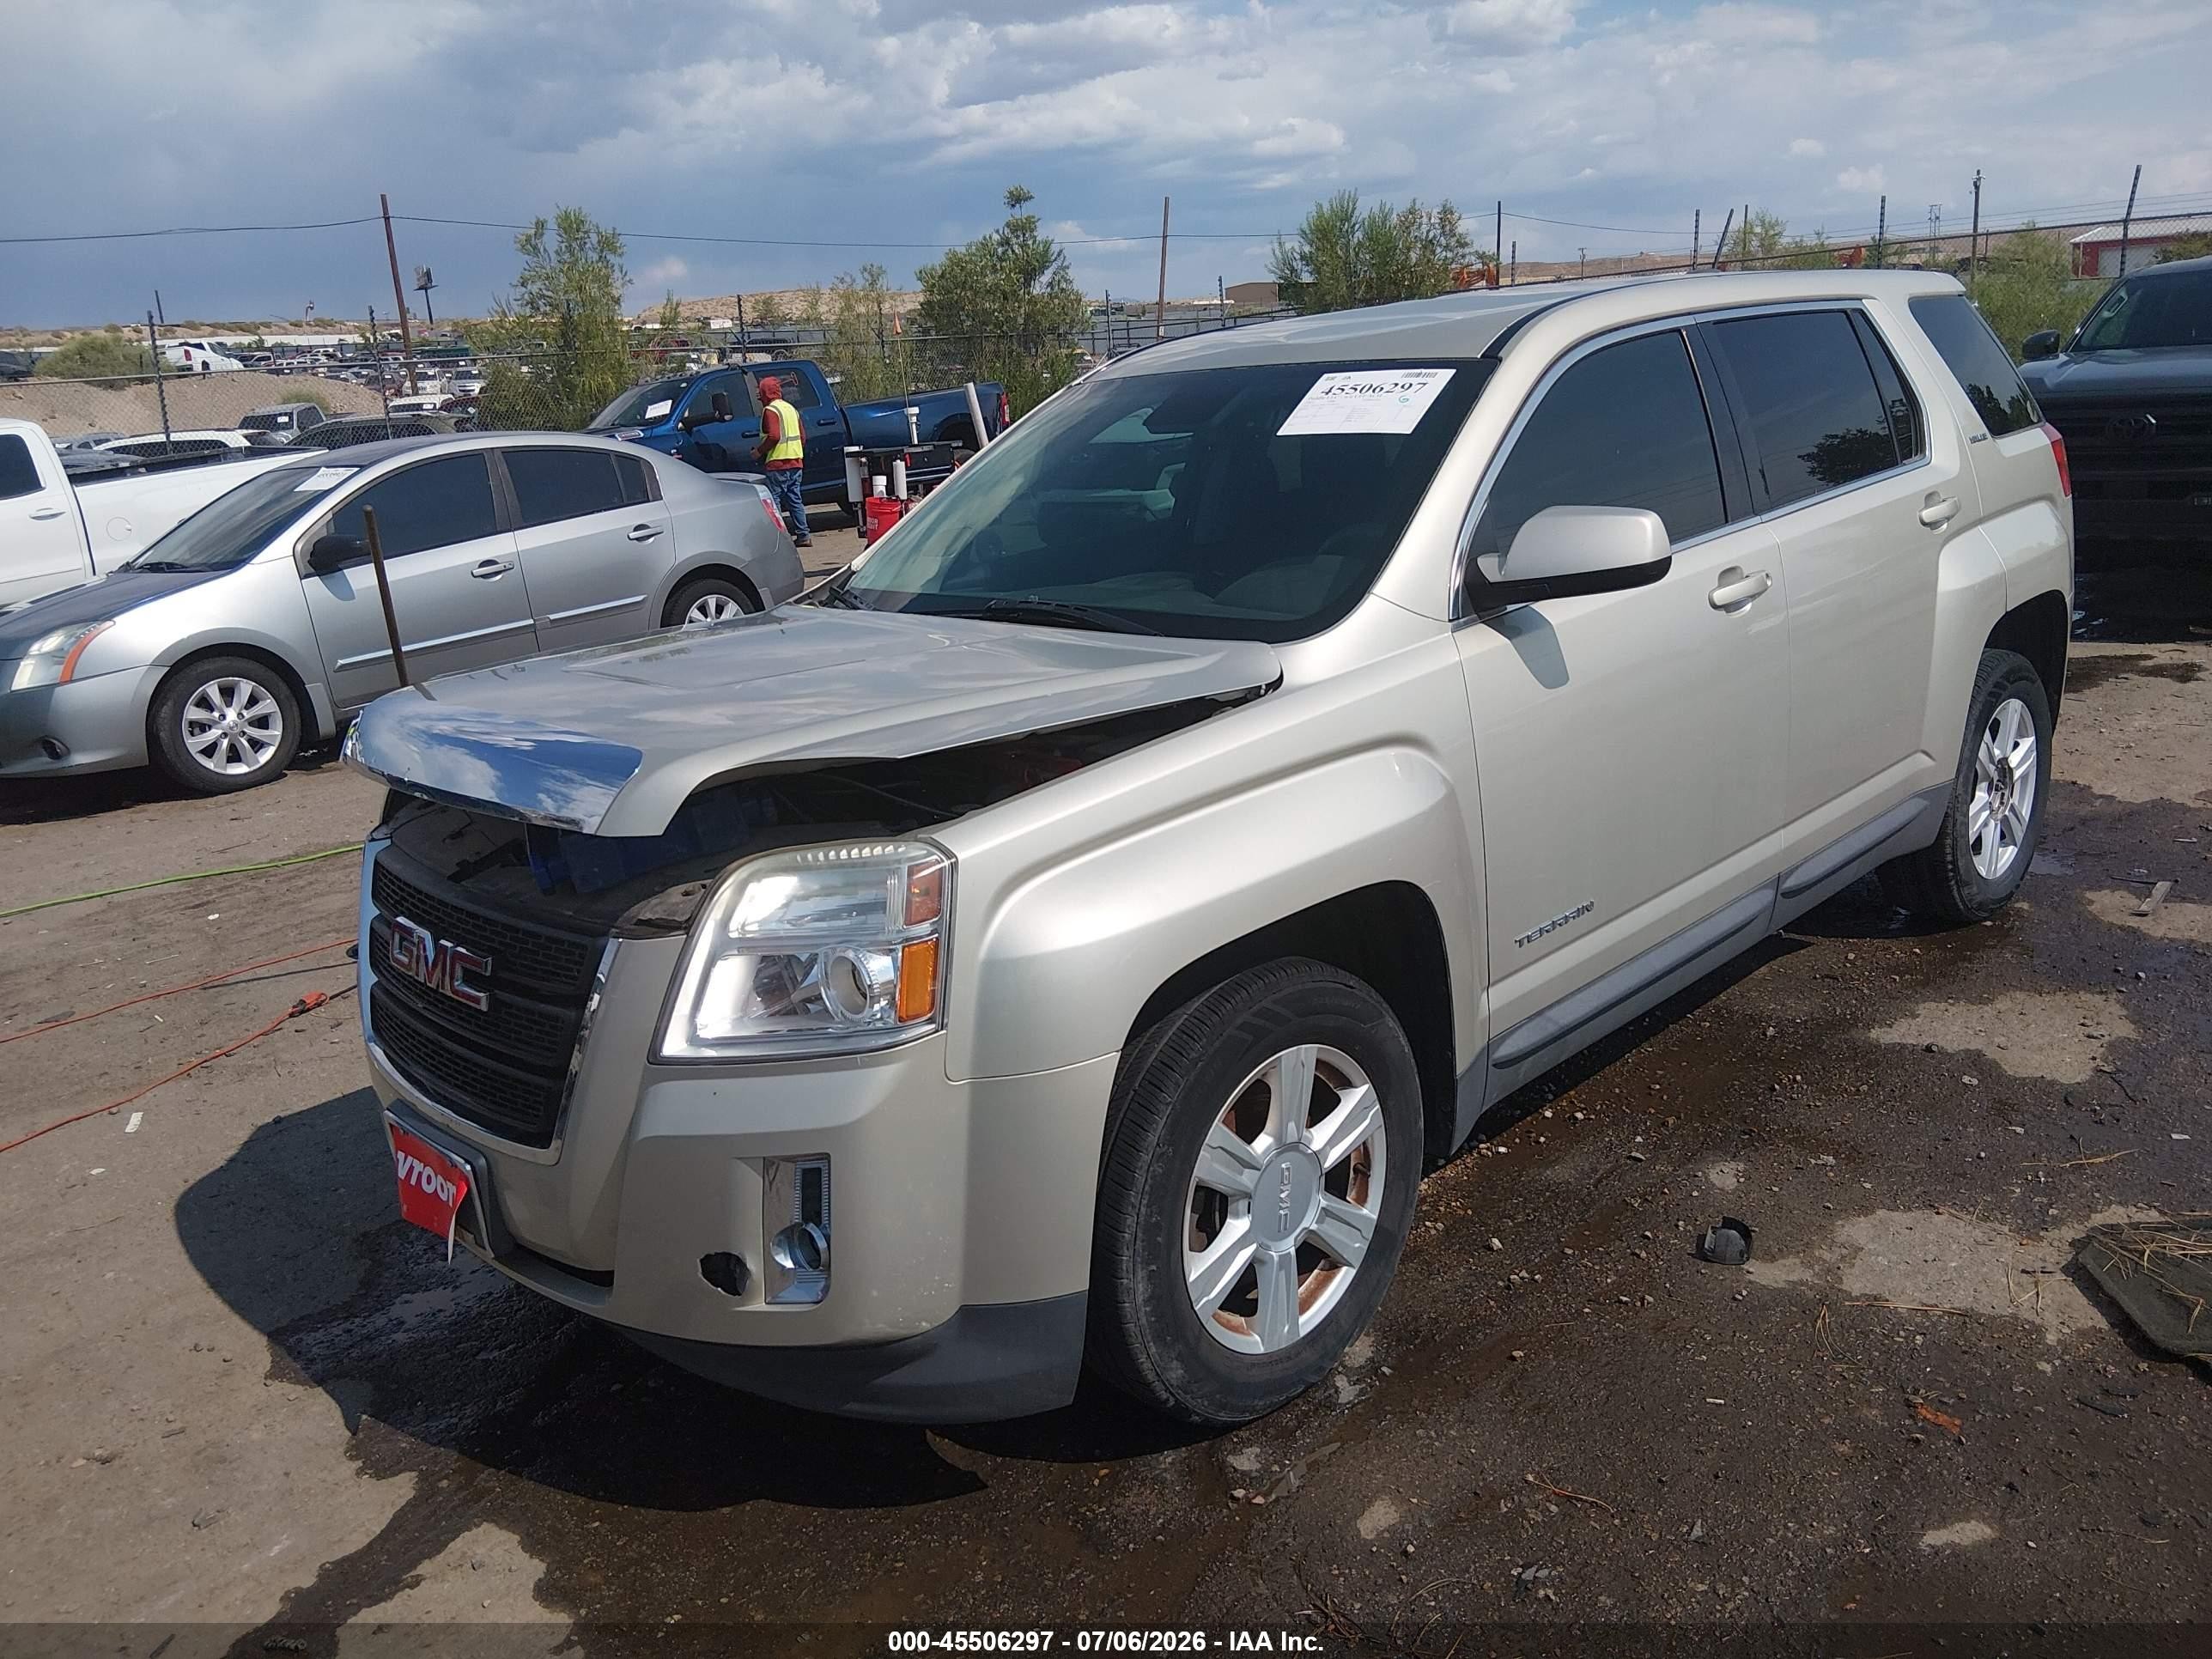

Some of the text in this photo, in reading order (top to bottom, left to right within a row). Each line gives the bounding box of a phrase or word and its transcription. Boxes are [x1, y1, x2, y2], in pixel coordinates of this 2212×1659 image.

[1321, 382, 1429, 396] 45506297
[1514, 899, 1595, 949] TERRAIN
[390, 916, 493, 1012] GMC
[1277, 1161, 1292, 1233] GMC
